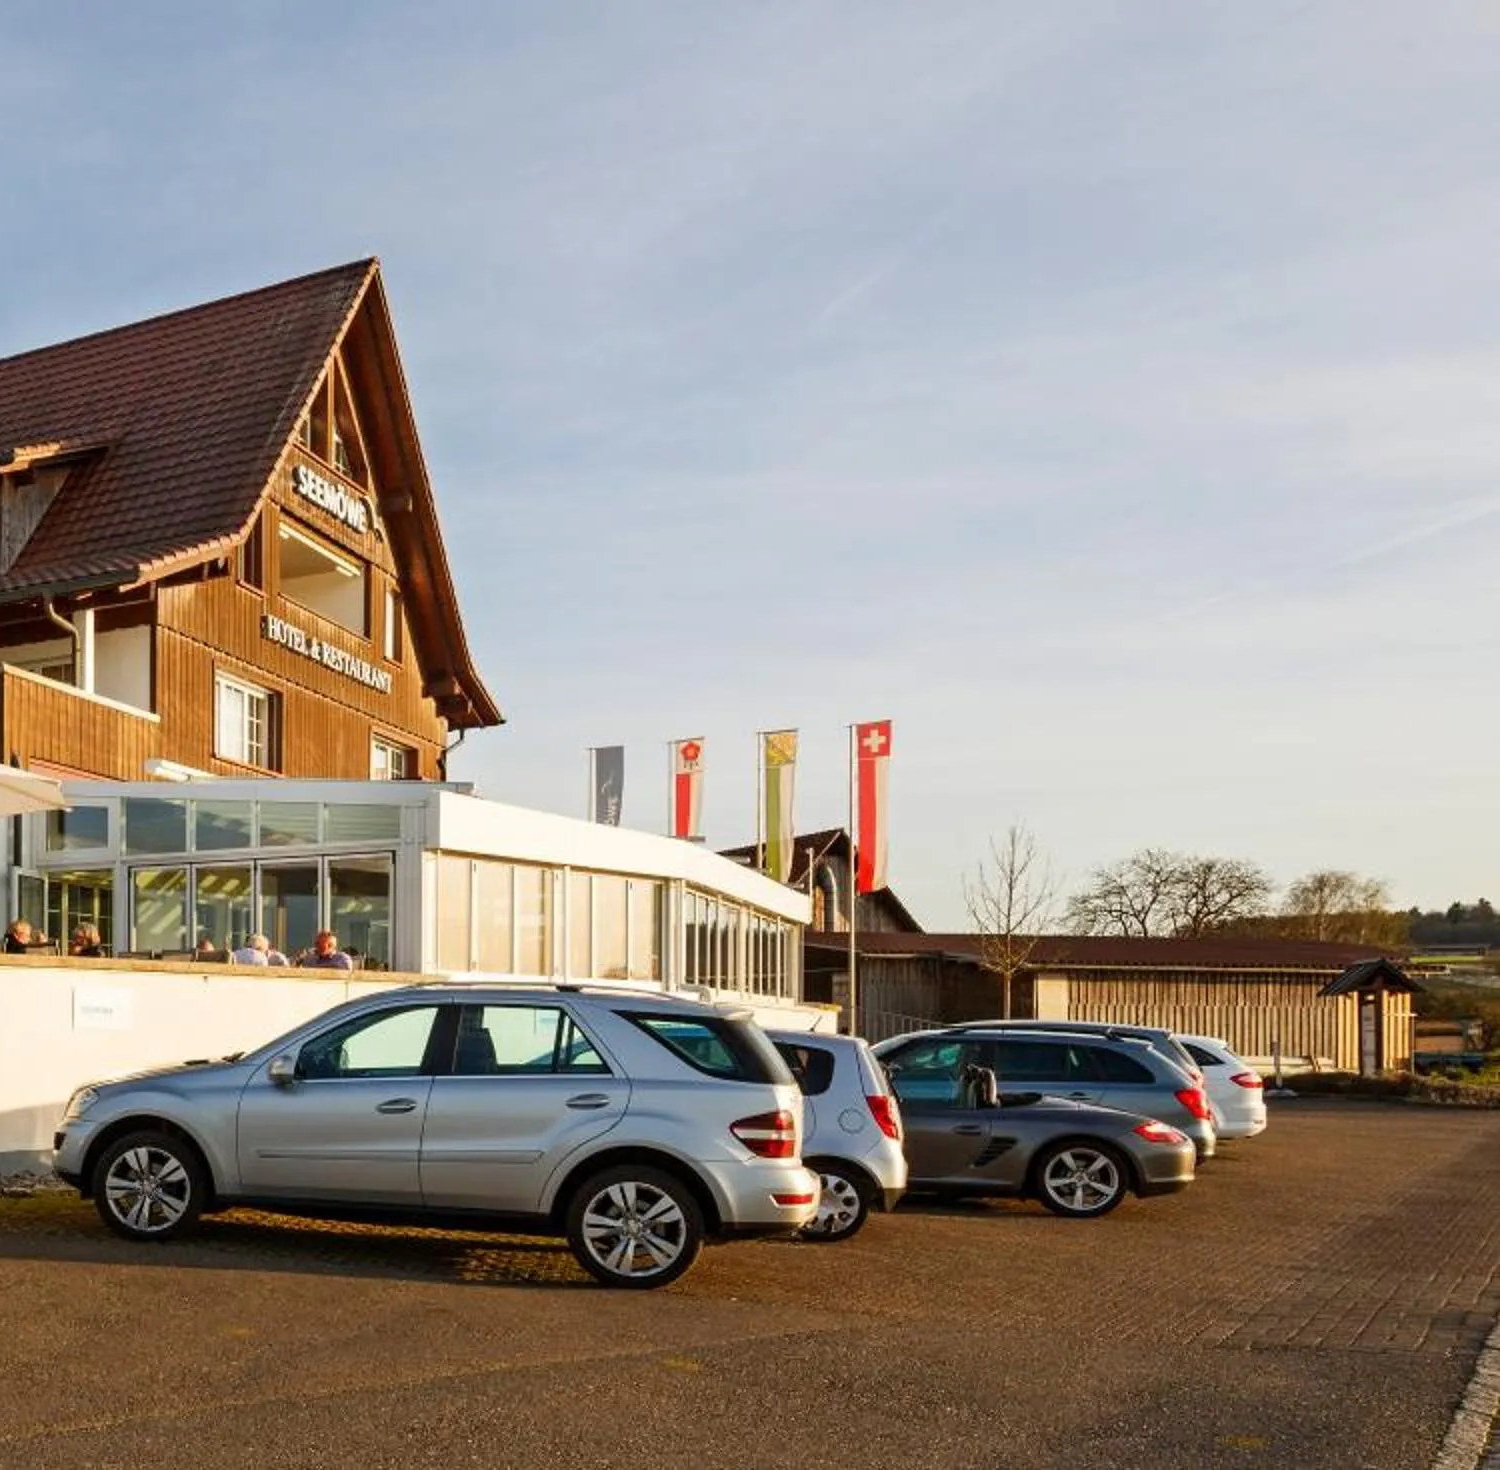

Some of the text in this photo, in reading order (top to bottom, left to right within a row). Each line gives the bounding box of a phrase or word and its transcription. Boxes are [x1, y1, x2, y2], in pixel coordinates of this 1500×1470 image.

[298, 464, 368, 534] SEEMÖWE
[267, 614, 392, 694] HOTEL & RESTAURANT
